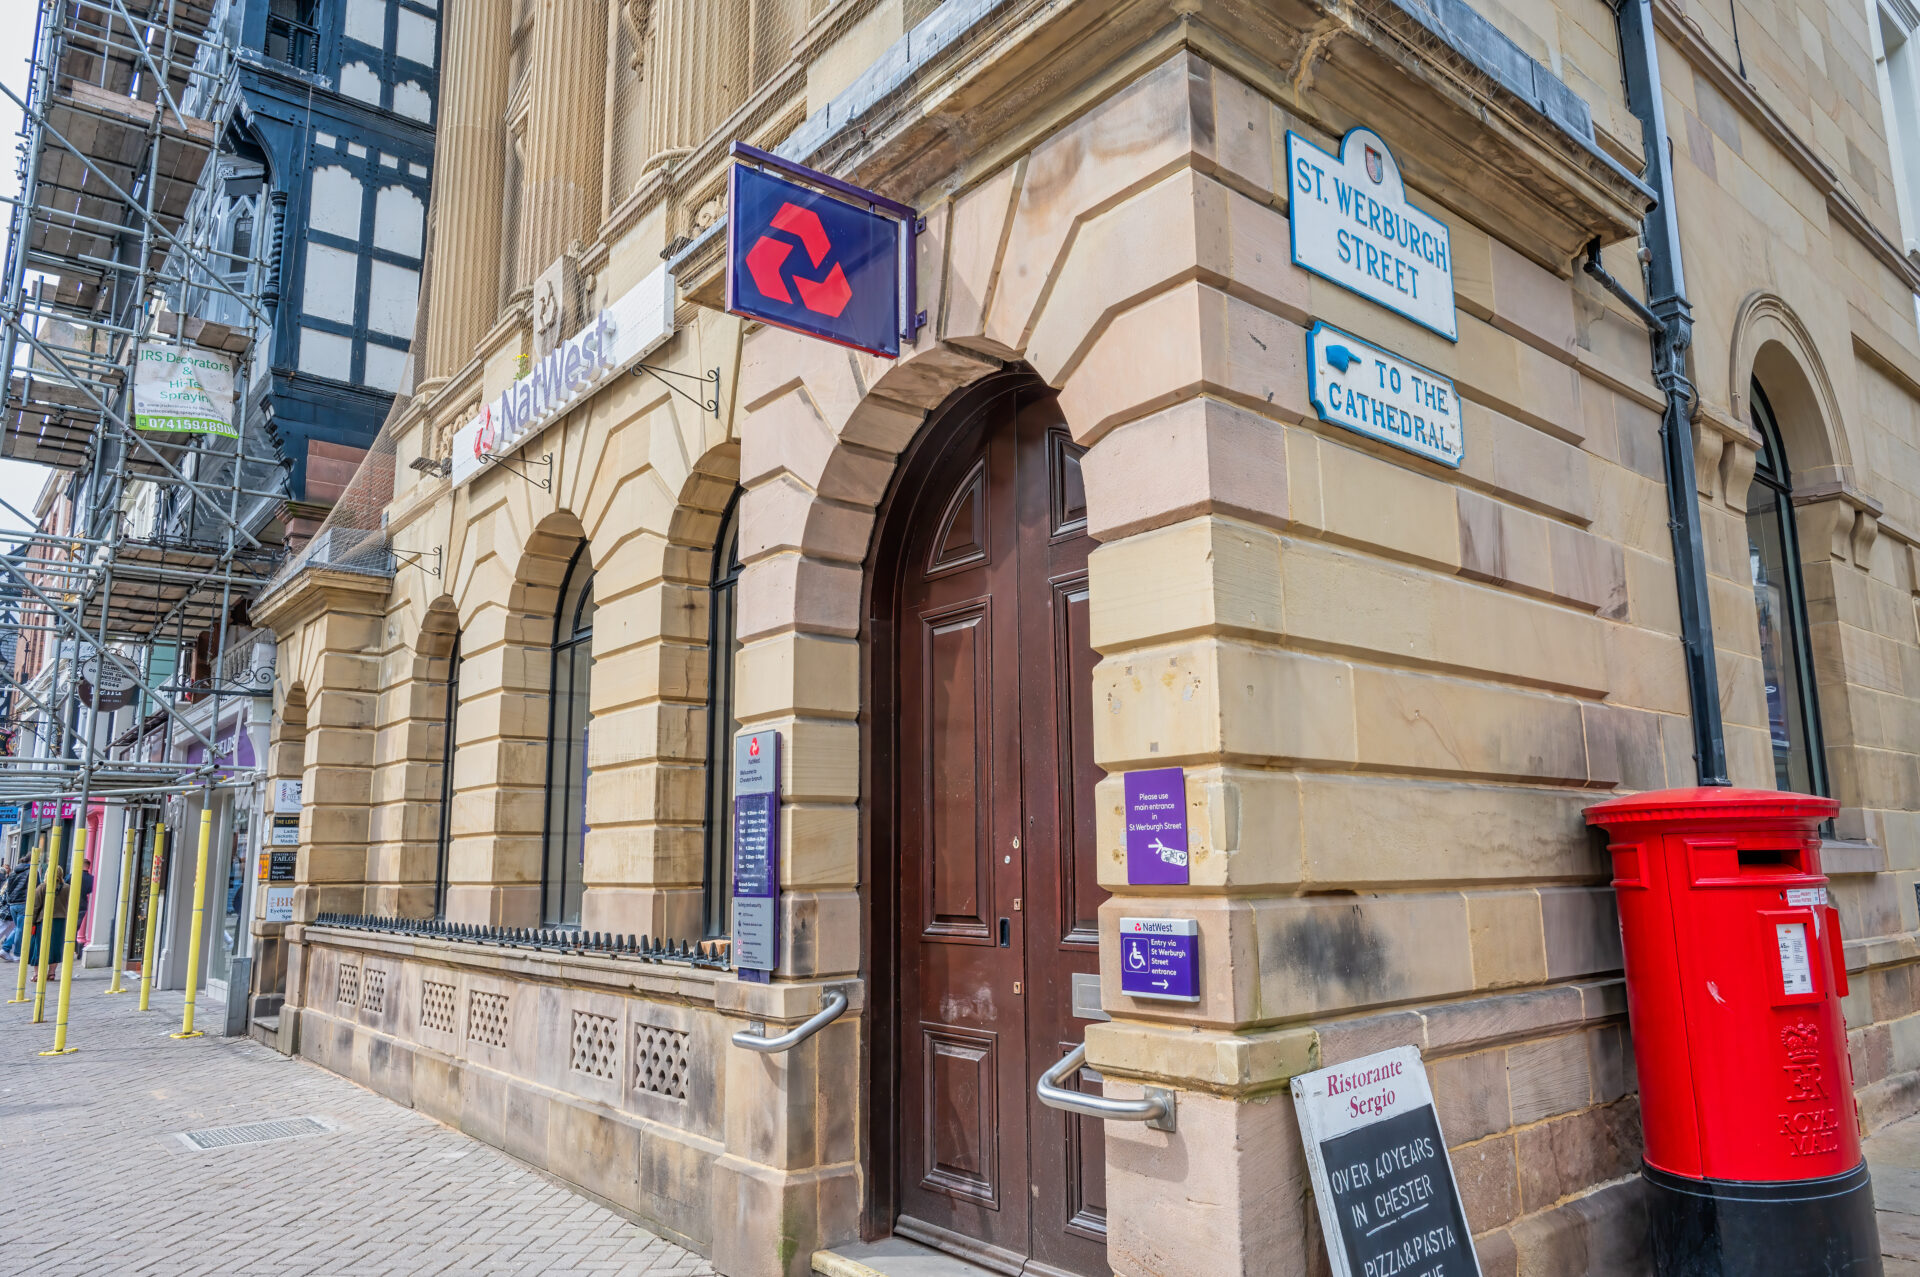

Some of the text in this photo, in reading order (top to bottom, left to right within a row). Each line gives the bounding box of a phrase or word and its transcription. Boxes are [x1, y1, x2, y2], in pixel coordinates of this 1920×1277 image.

[1296, 157, 1448, 273] ST. WERBURGH
[1337, 228, 1419, 300] STREET
[139, 350, 230, 373] JRS Decorators
[182, 366, 193, 376] &
[501, 310, 611, 442] NatWest
[169, 378, 202, 389] Hi-Te
[1375, 359, 1449, 416] TO THE
[160, 391, 211, 404] Sprayin
[1328, 382, 1456, 456] CATHEDRAL.
[1139, 793, 1158, 801] Please
[1134, 803, 1149, 811] main
[1151, 812, 1158, 820] in
[1128, 822, 1182, 833] St Werburgh Street
[1143, 922, 1173, 932] NatWest
[1151, 938, 1177, 947] Entry via
[1151, 957, 1169, 966] Street
[1158, 948, 1186, 959] Werburgh
[1151, 968, 1177, 976] entrance
[1326, 1060, 1403, 1098] Ristorante
[1349, 1087, 1396, 1119] Sergio
[1778, 1108, 1839, 1135] ROYAL
[1789, 1131, 1838, 1157] MAIL
[1331, 1163, 1372, 1195] OVER
[1351, 1174, 1434, 1229] IN CHESTER
